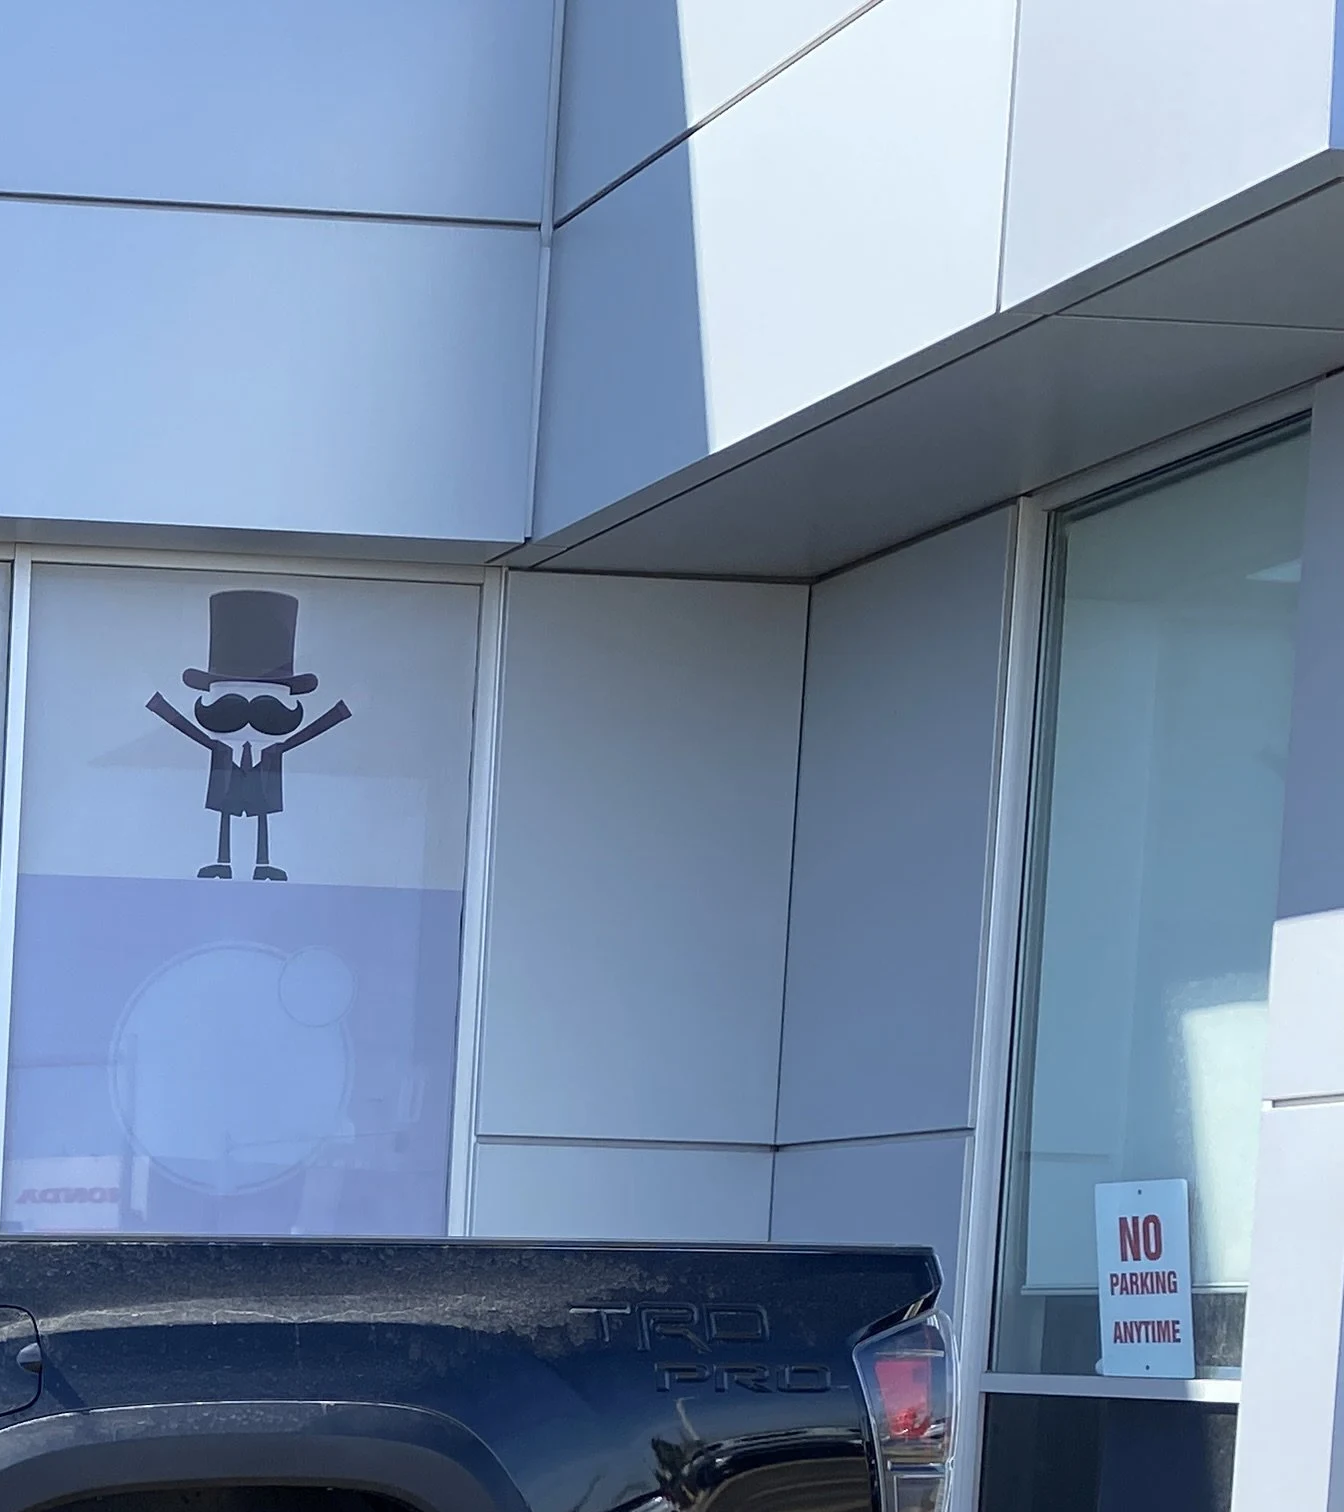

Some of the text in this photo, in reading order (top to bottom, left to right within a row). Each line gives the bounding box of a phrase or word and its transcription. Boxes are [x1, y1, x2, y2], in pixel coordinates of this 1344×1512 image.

[1118, 1214, 1162, 1262] NO
[1110, 1270, 1178, 1297] PARKING
[568, 1301, 772, 1353] TRD
[1113, 1319, 1182, 1344] ANYTIME
[653, 1362, 833, 1393] PRO
